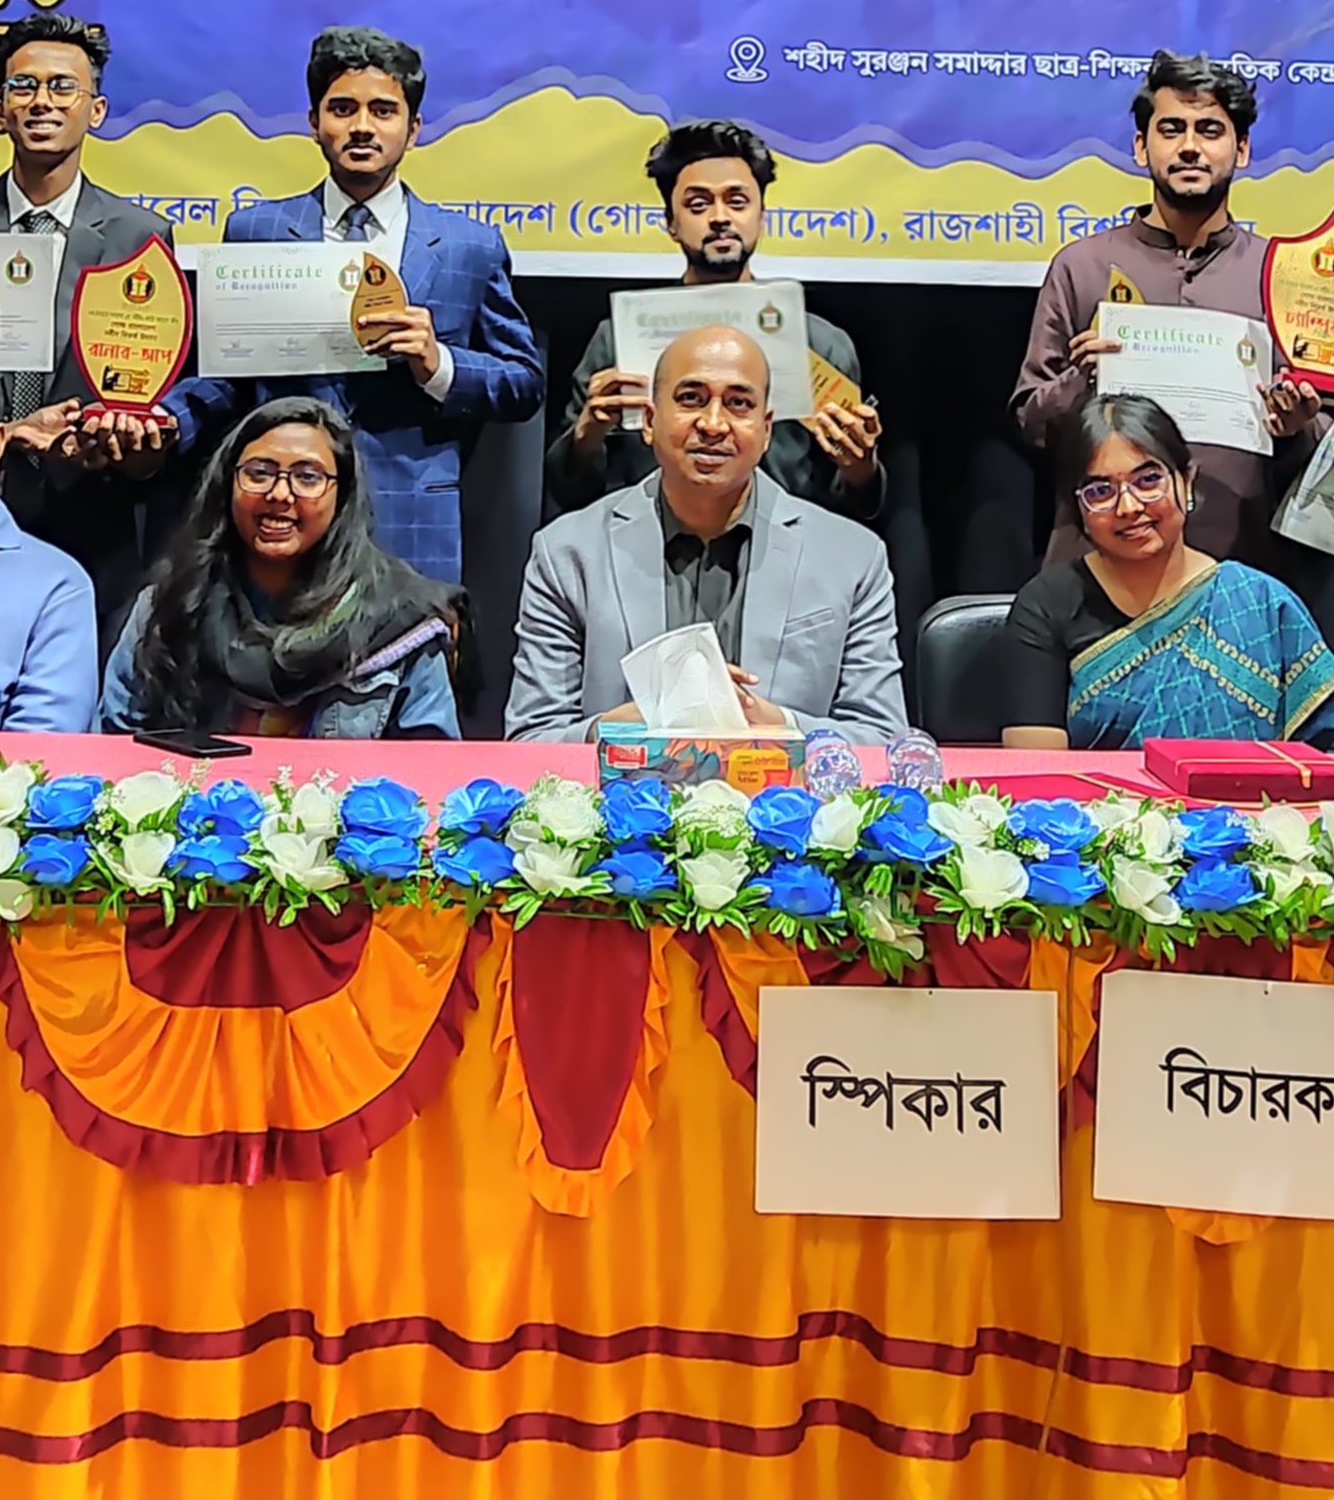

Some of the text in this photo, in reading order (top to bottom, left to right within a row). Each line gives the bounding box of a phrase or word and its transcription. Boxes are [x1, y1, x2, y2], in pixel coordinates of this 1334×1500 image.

[783, 41, 847, 73] শহীদ
[851, 49, 928, 78] সুরঞ্জন
[933, 51, 1027, 77] সমাদ্দার
[903, 203, 1046, 244] রাজশাহী
[215, 264, 324, 280] Certificate
[1116, 324, 1225, 347] Certificate
[801, 1054, 1006, 1134] স্পিকার
